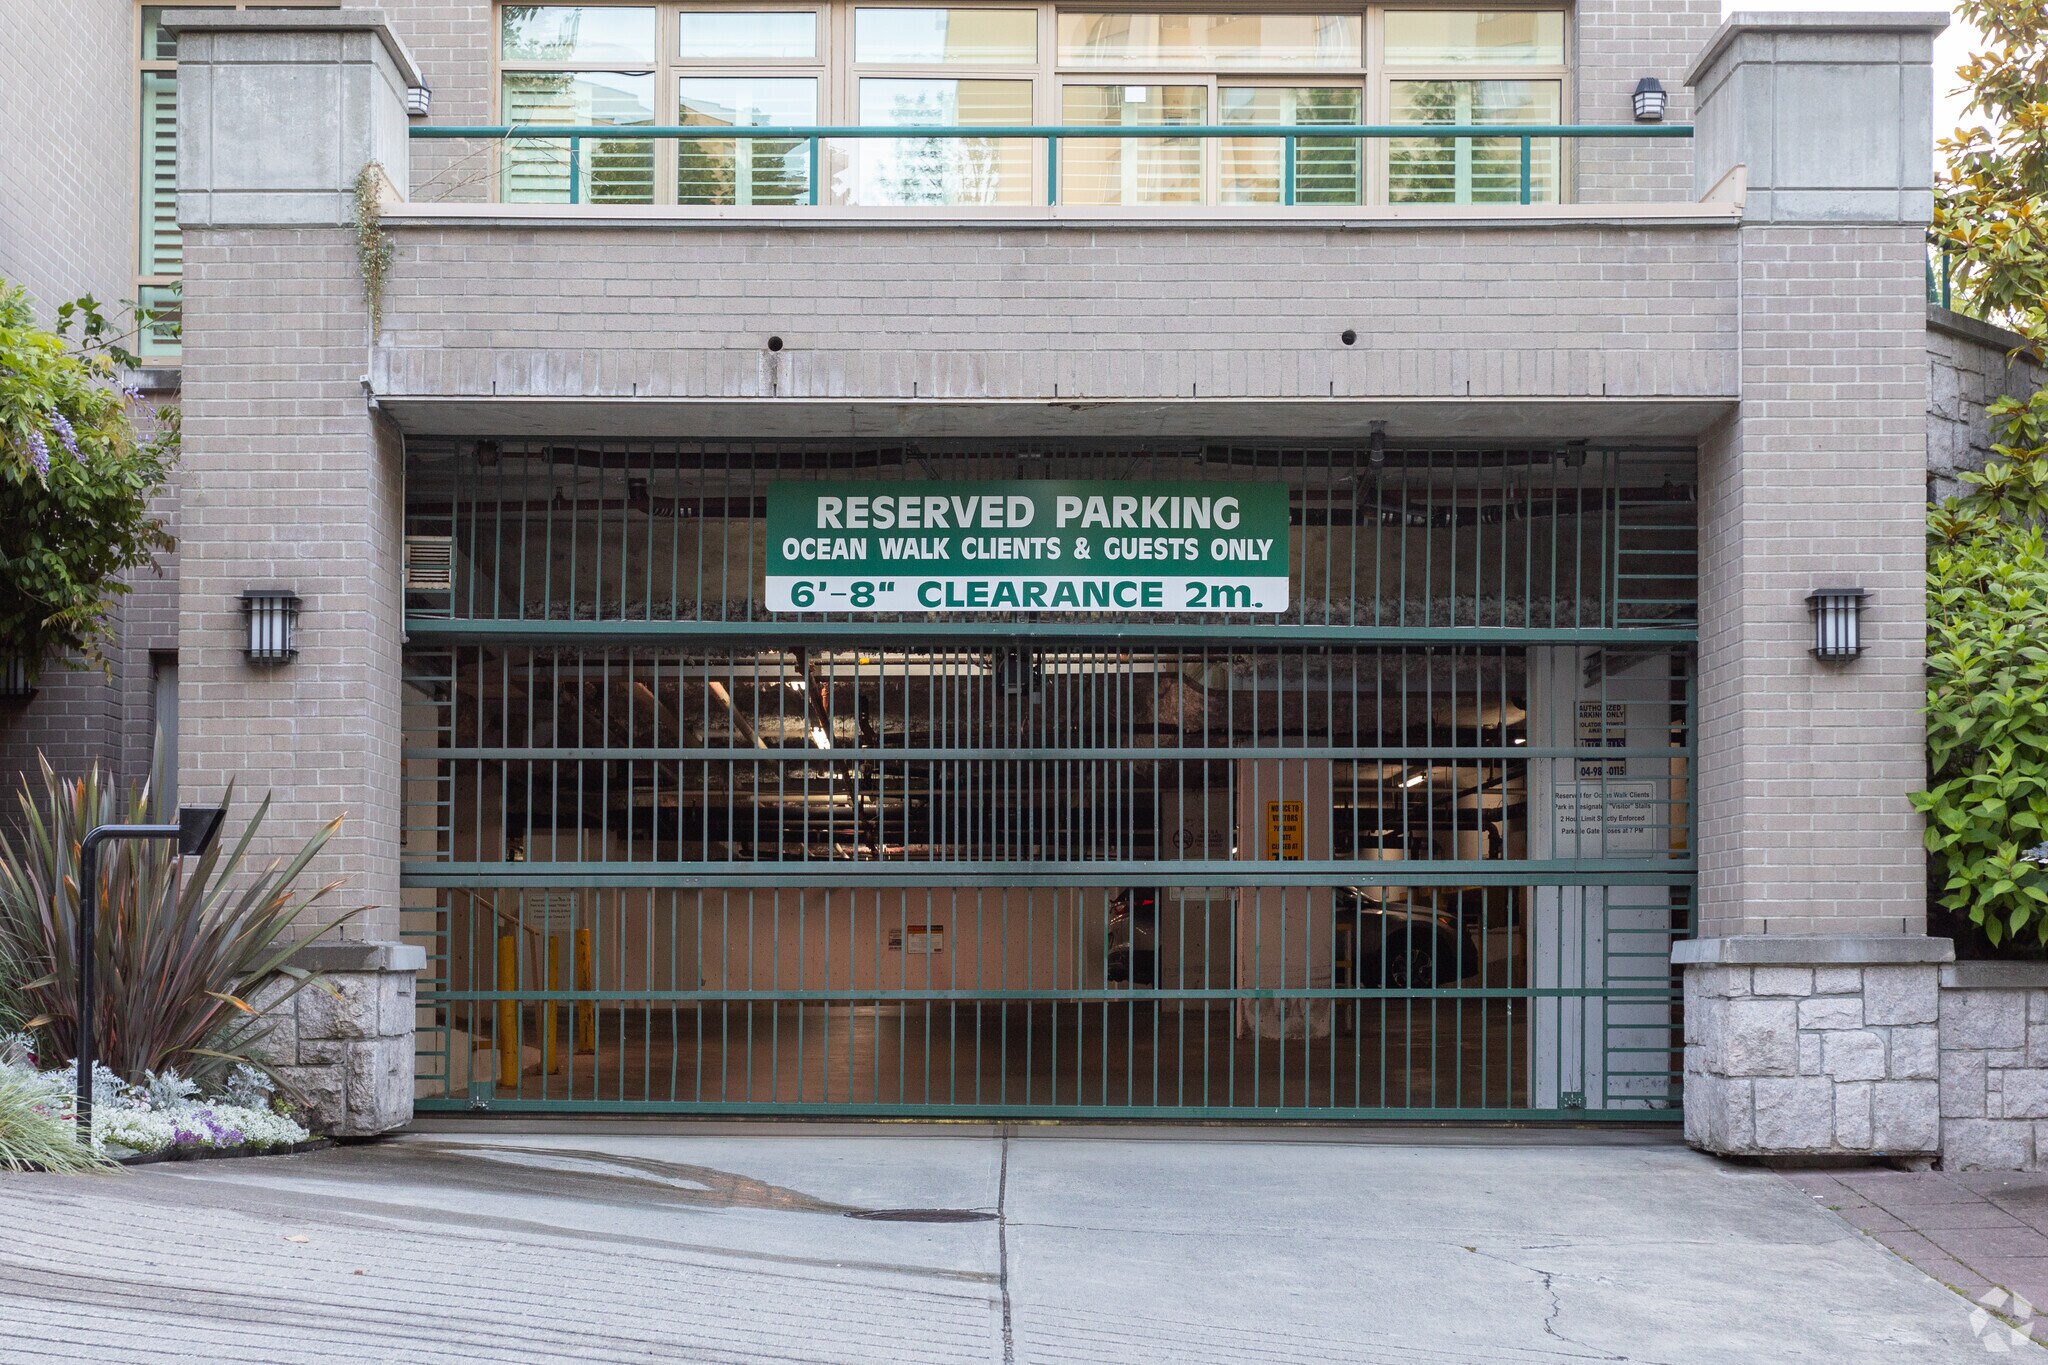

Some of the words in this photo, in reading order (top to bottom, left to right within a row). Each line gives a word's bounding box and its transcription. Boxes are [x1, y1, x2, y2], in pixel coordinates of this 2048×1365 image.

[817, 496, 1035, 529] RESERVED
[1056, 496, 1241, 529] PARKING
[782, 537, 868, 560] OCEAN
[879, 538, 950, 560] WALK
[961, 537, 1061, 560] CLIENTS
[1073, 537, 1092, 560] &
[1104, 537, 1199, 560] GUESTS
[1210, 538, 1274, 561] ONLY
[917, 580, 1163, 608] CLEARANCE
[1185, 580, 1264, 609] 2m.
[1578, 766, 1625, 776] 04-98-0115
[1271, 804, 1291, 812] NOICE
[1618, 814, 1645, 822] Enforced
